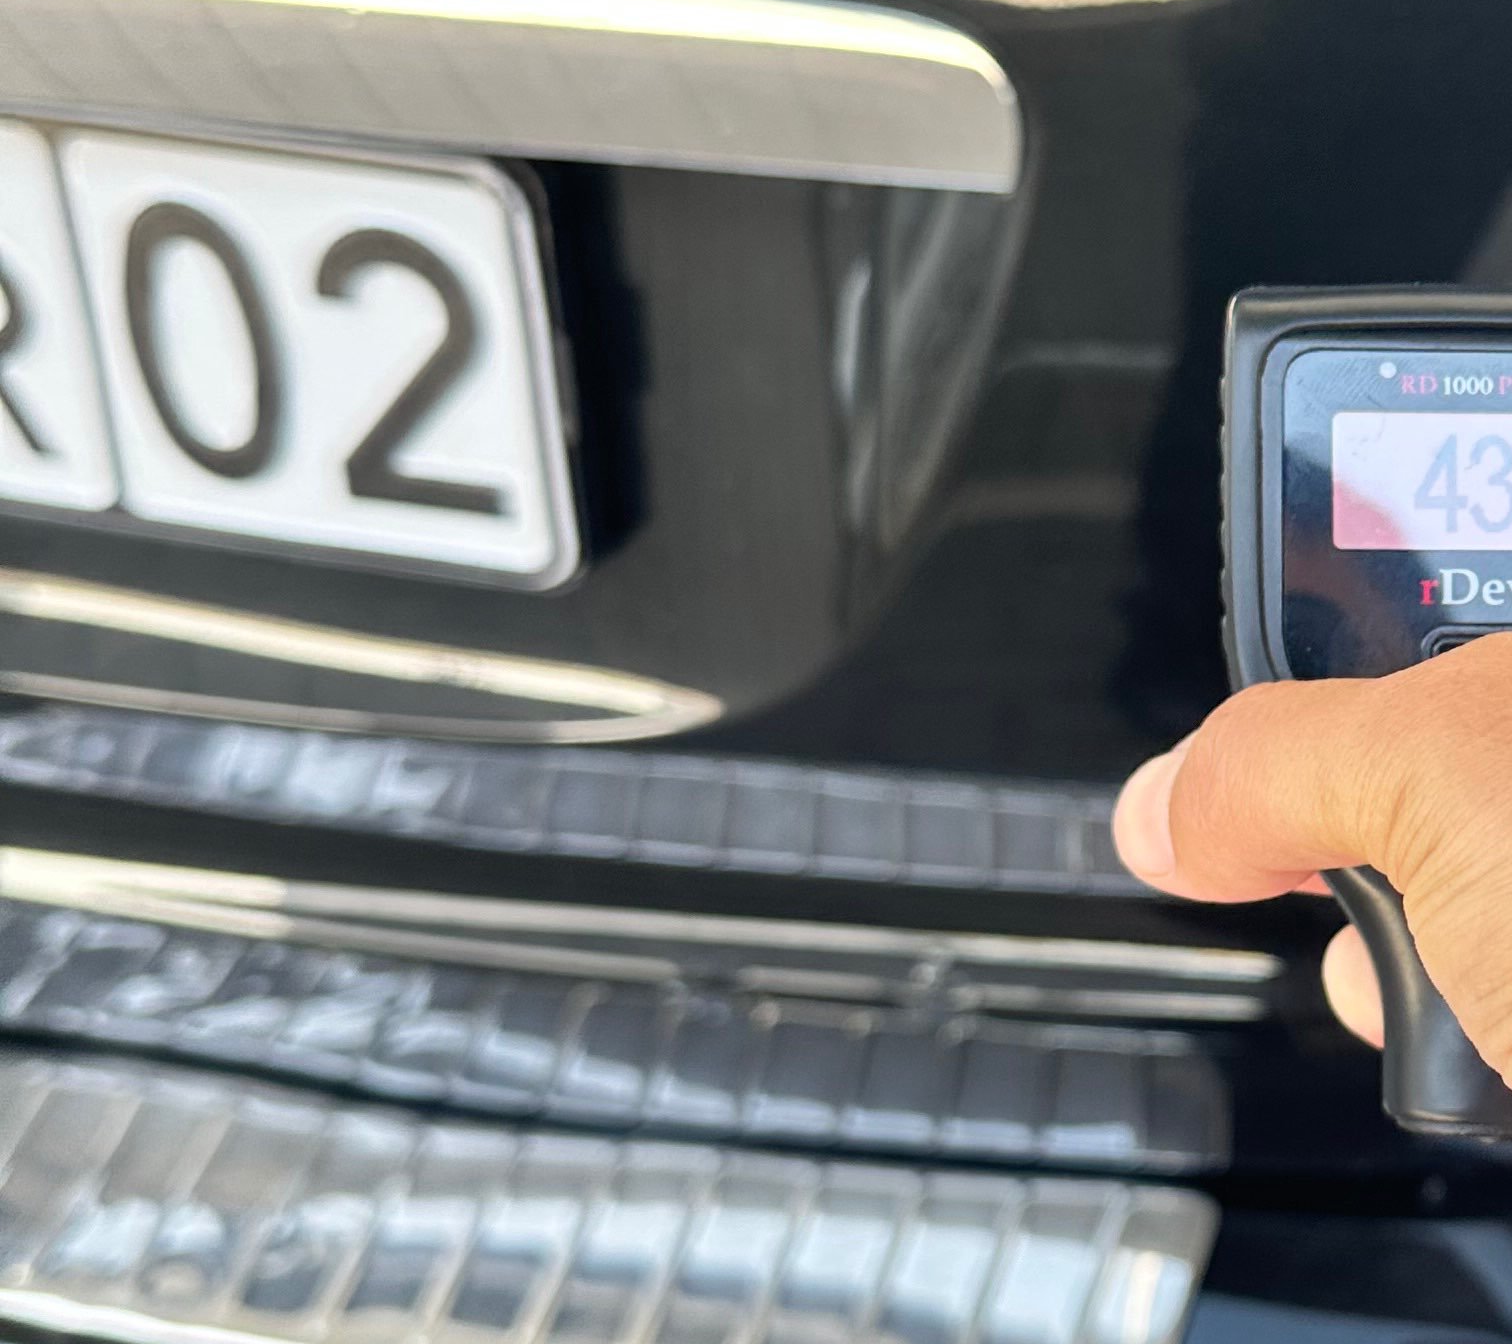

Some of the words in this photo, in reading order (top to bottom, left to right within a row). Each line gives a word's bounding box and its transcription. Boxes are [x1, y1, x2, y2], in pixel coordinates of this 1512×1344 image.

[124, 200, 512, 518] 02
[1401, 375, 1438, 395] RD
[1443, 376, 1493, 395] 1000
